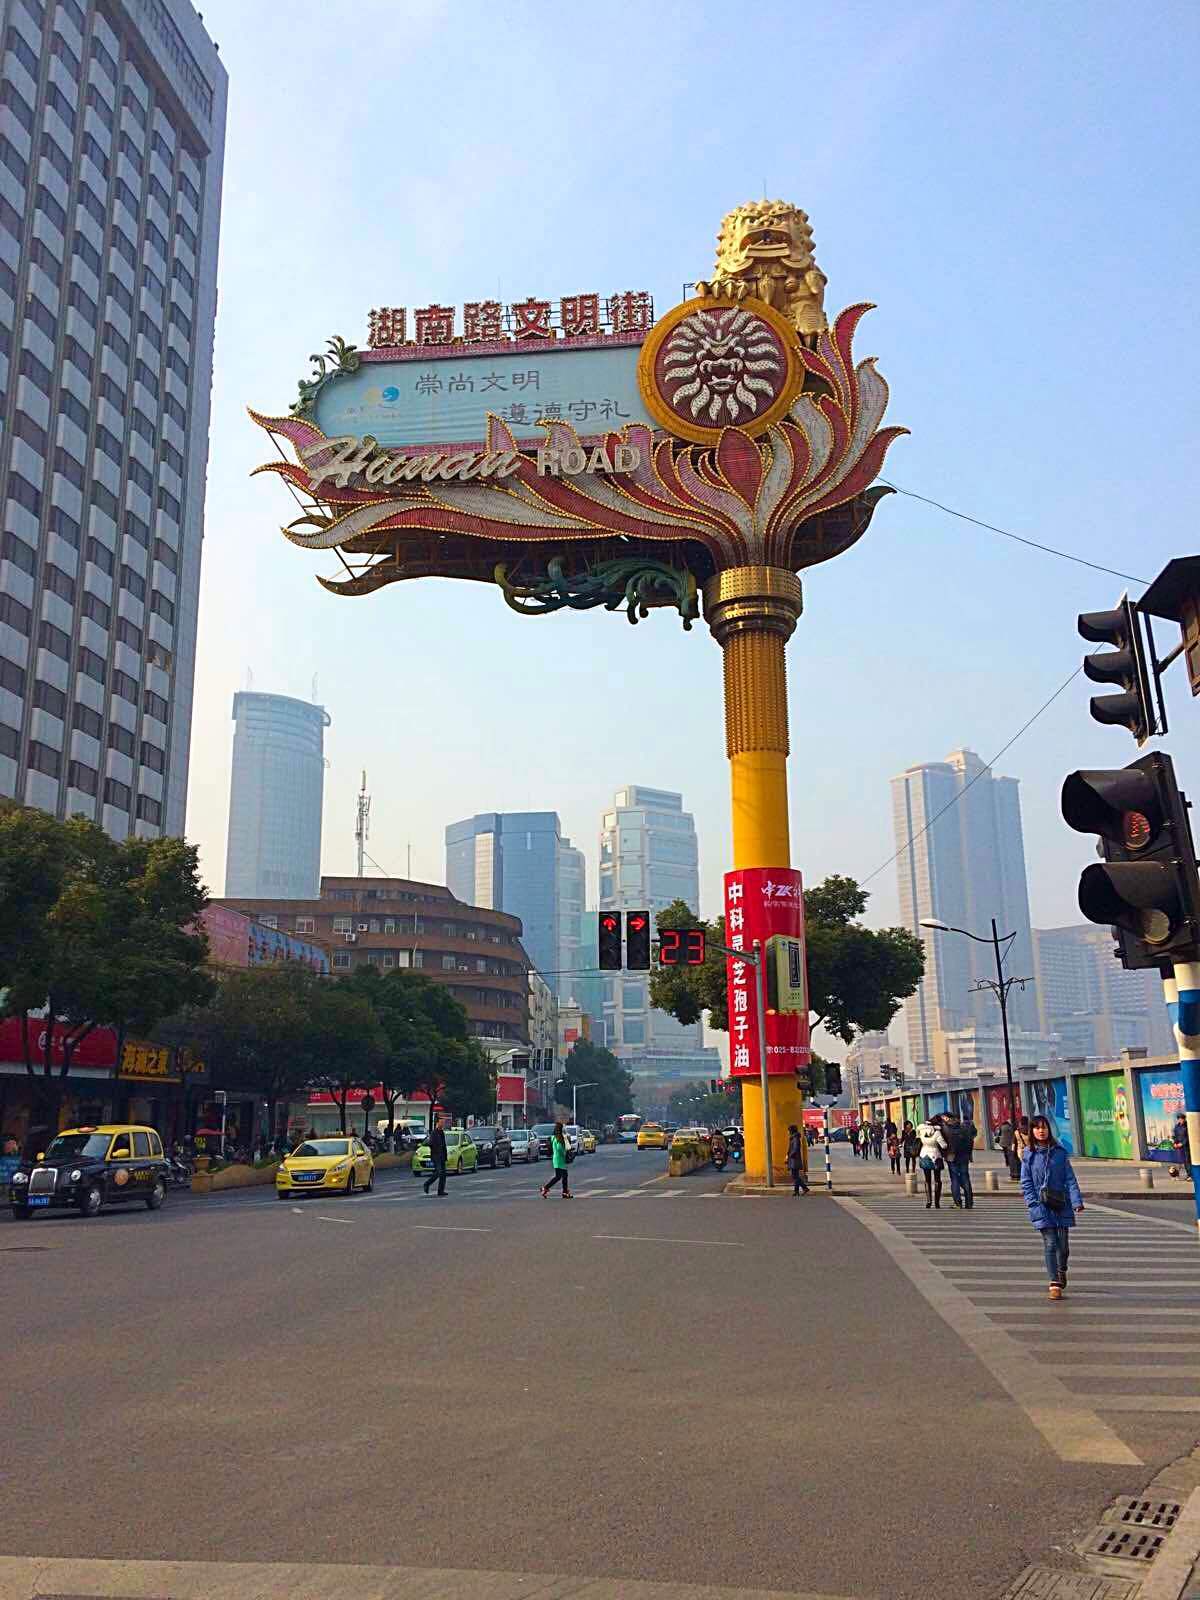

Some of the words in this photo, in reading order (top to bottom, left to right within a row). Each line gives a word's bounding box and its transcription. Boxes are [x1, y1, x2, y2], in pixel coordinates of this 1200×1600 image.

[367, 291, 652, 348] 湖南路文明街
[415, 371, 541, 396] 崇尚文明
[502, 398, 631, 426] 遵德守礼
[303, 436, 522, 489] Hunan
[537, 443, 641, 477] ROAD
[660, 930, 705, 965] 23
